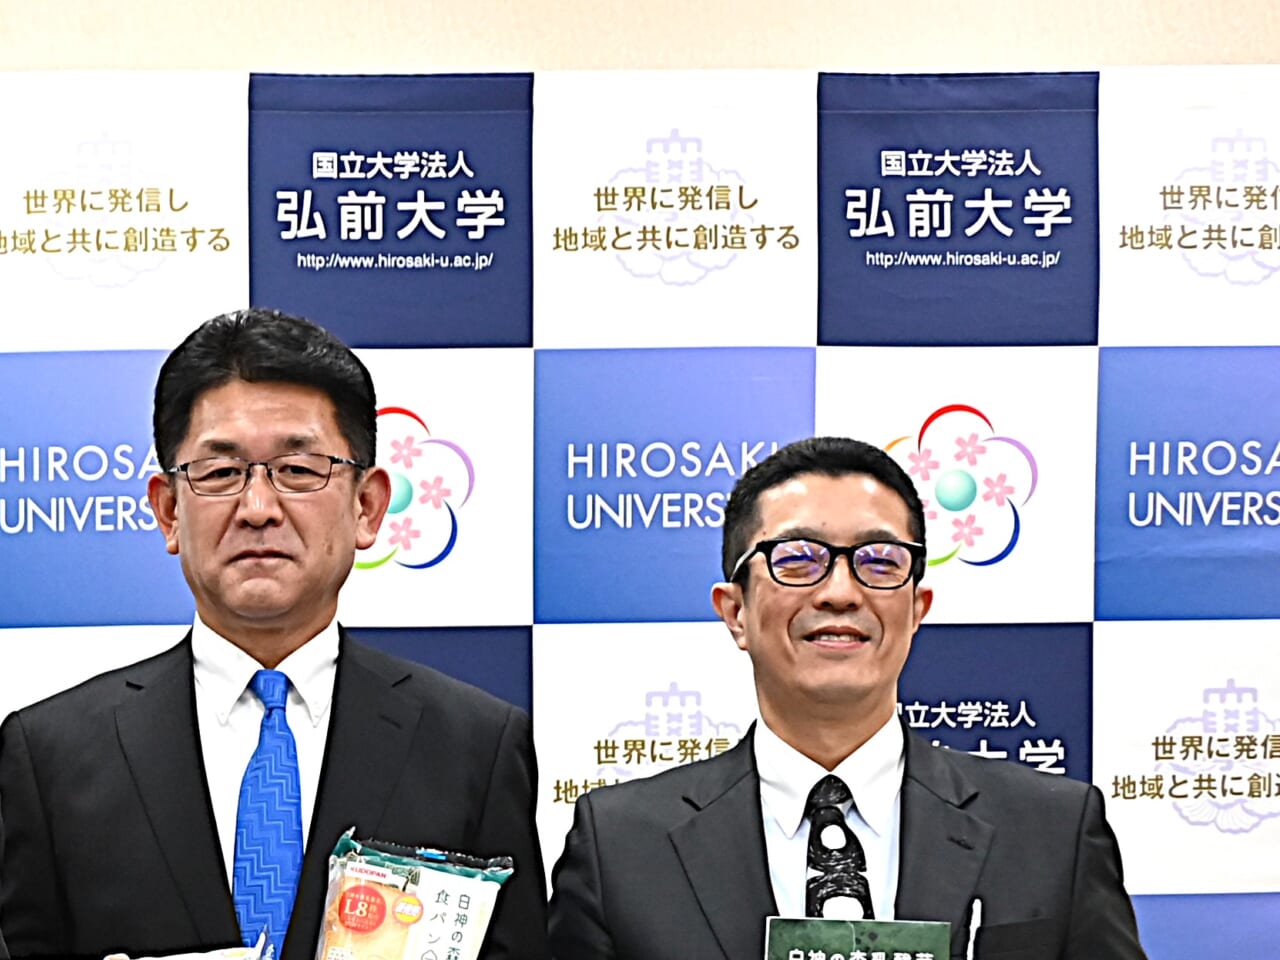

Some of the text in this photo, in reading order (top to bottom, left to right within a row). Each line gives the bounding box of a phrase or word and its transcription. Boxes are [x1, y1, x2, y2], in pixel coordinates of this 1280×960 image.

[312, 150, 474, 179] 国立大学法人
[881, 149, 1041, 177] 国立大学法人
[23, 188, 188, 215] 世界に発信し
[593, 185, 759, 212] 世界に発信し
[845, 188, 1072, 237] 弘前大学
[276, 189, 505, 240] 弘前大学
[552, 224, 800, 252] 地域と共に創造する
[297, 253, 493, 270] http://www.hirosaki-u.ac.jp/
[866, 251, 1060, 268] http://www.hirosaki-u.ac.jp/
[567, 492, 731, 529] UNIVERS
[896, 701, 1036, 729] 立大学法人
[1111, 773, 1280, 800] 地域と共に創
[428, 888, 451, 945] 食パン
